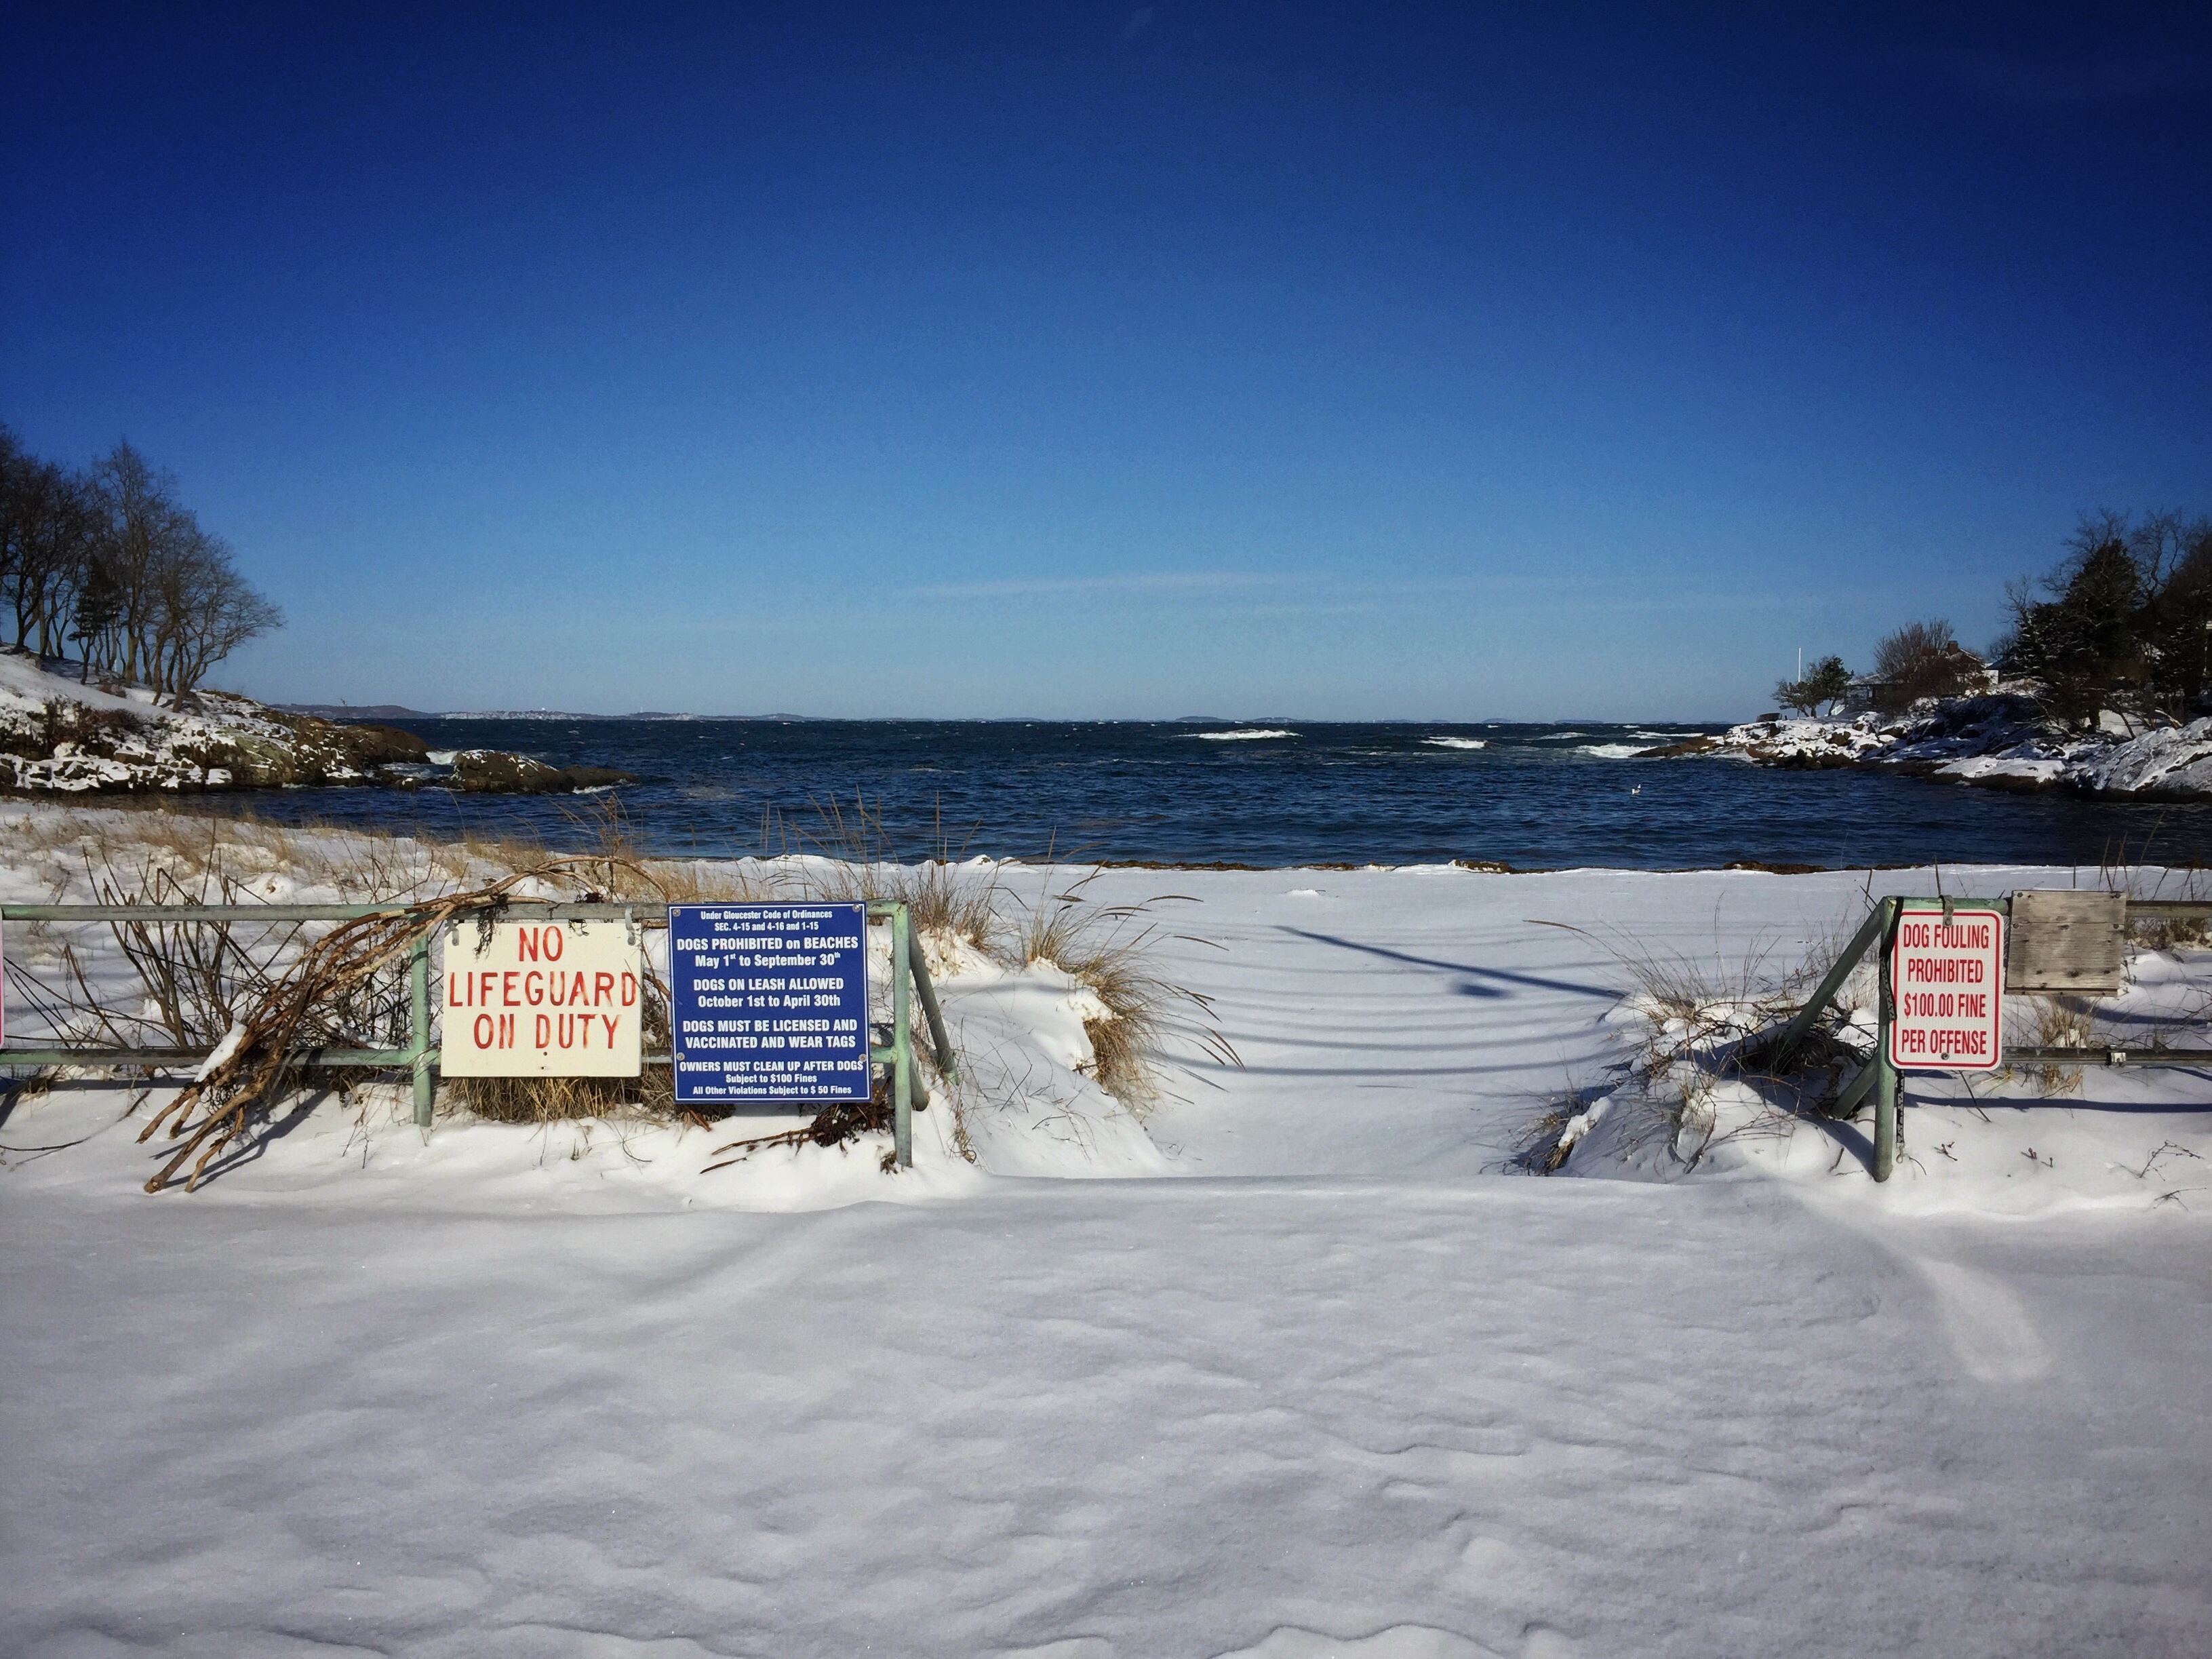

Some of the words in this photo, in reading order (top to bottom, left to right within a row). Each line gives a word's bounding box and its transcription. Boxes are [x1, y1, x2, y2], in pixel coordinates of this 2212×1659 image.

[700, 911, 722, 920] Under
[724, 911, 761, 920] Gloucester
[763, 911, 781, 919] Code
[792, 910, 833, 918] Ordinances
[715, 922, 731, 931] SEC.
[733, 922, 750, 931] 4-15
[752, 922, 765, 931] and
[767, 922, 784, 930] 4-16
[786, 922, 799, 930] and
[802, 922, 818, 930] 1-15
[677, 939, 708, 950] DOGS
[712, 938, 783, 950] PROHIBITED
[786, 940, 800, 949] on
[804, 937, 858, 949] BEACHES
[1903, 924, 1929, 948] DOG
[1935, 924, 1989, 949] FOULING
[519, 926, 563, 962] NO
[695, 955, 719, 969] May
[739, 955, 751, 966] to
[754, 954, 816, 968] September
[1908, 958, 1983, 983] PROHIBITED
[450, 971, 637, 1007] LIFEGUARD
[694, 979, 725, 991] DOGS
[728, 979, 745, 990] ON
[749, 978, 785, 990] LEASH
[789, 977, 844, 990] ALLOWED
[698, 996, 743, 1007] October
[747, 996, 765, 1007] 1st
[768, 996, 780, 1007] to
[783, 995, 810, 1009] April
[814, 995, 840, 1006] 30th
[1904, 992, 1954, 1019] $100.00
[1958, 994, 1986, 1017] FINE
[474, 1014, 514, 1049] ON
[536, 1014, 622, 1049] DUTY
[683, 1020, 714, 1032] DOGS
[718, 1020, 751, 1032] MUST
[755, 1020, 769, 1032] BE
[773, 1019, 829, 1031] LICENSED
[833, 1019, 857, 1031] AND
[685, 1036, 757, 1049] VACCINATED
[761, 1036, 785, 1048] AND
[789, 1036, 823, 1047] WEAR
[826, 1036, 856, 1047] TAGS
[1902, 1030, 1925, 1053] PER
[1931, 1030, 1986, 1055] OFFENSE
[679, 1061, 721, 1072] OWNERS
[724, 1061, 751, 1071] MUST
[753, 1061, 784, 1071] CLEAN
[787, 1061, 801, 1071] UP
[804, 1061, 834, 1071] AFTER
[837, 1061, 863, 1070] DOGS
[726, 1074, 757, 1084] Subject
[770, 1074, 793, 1083] $100
[795, 1074, 817, 1082] Fines
[728, 1086, 767, 1094] Violations
[769, 1086, 799, 1095] Subject
[810, 1085, 816, 1094] $
[831, 1085, 852, 1093] Fines
